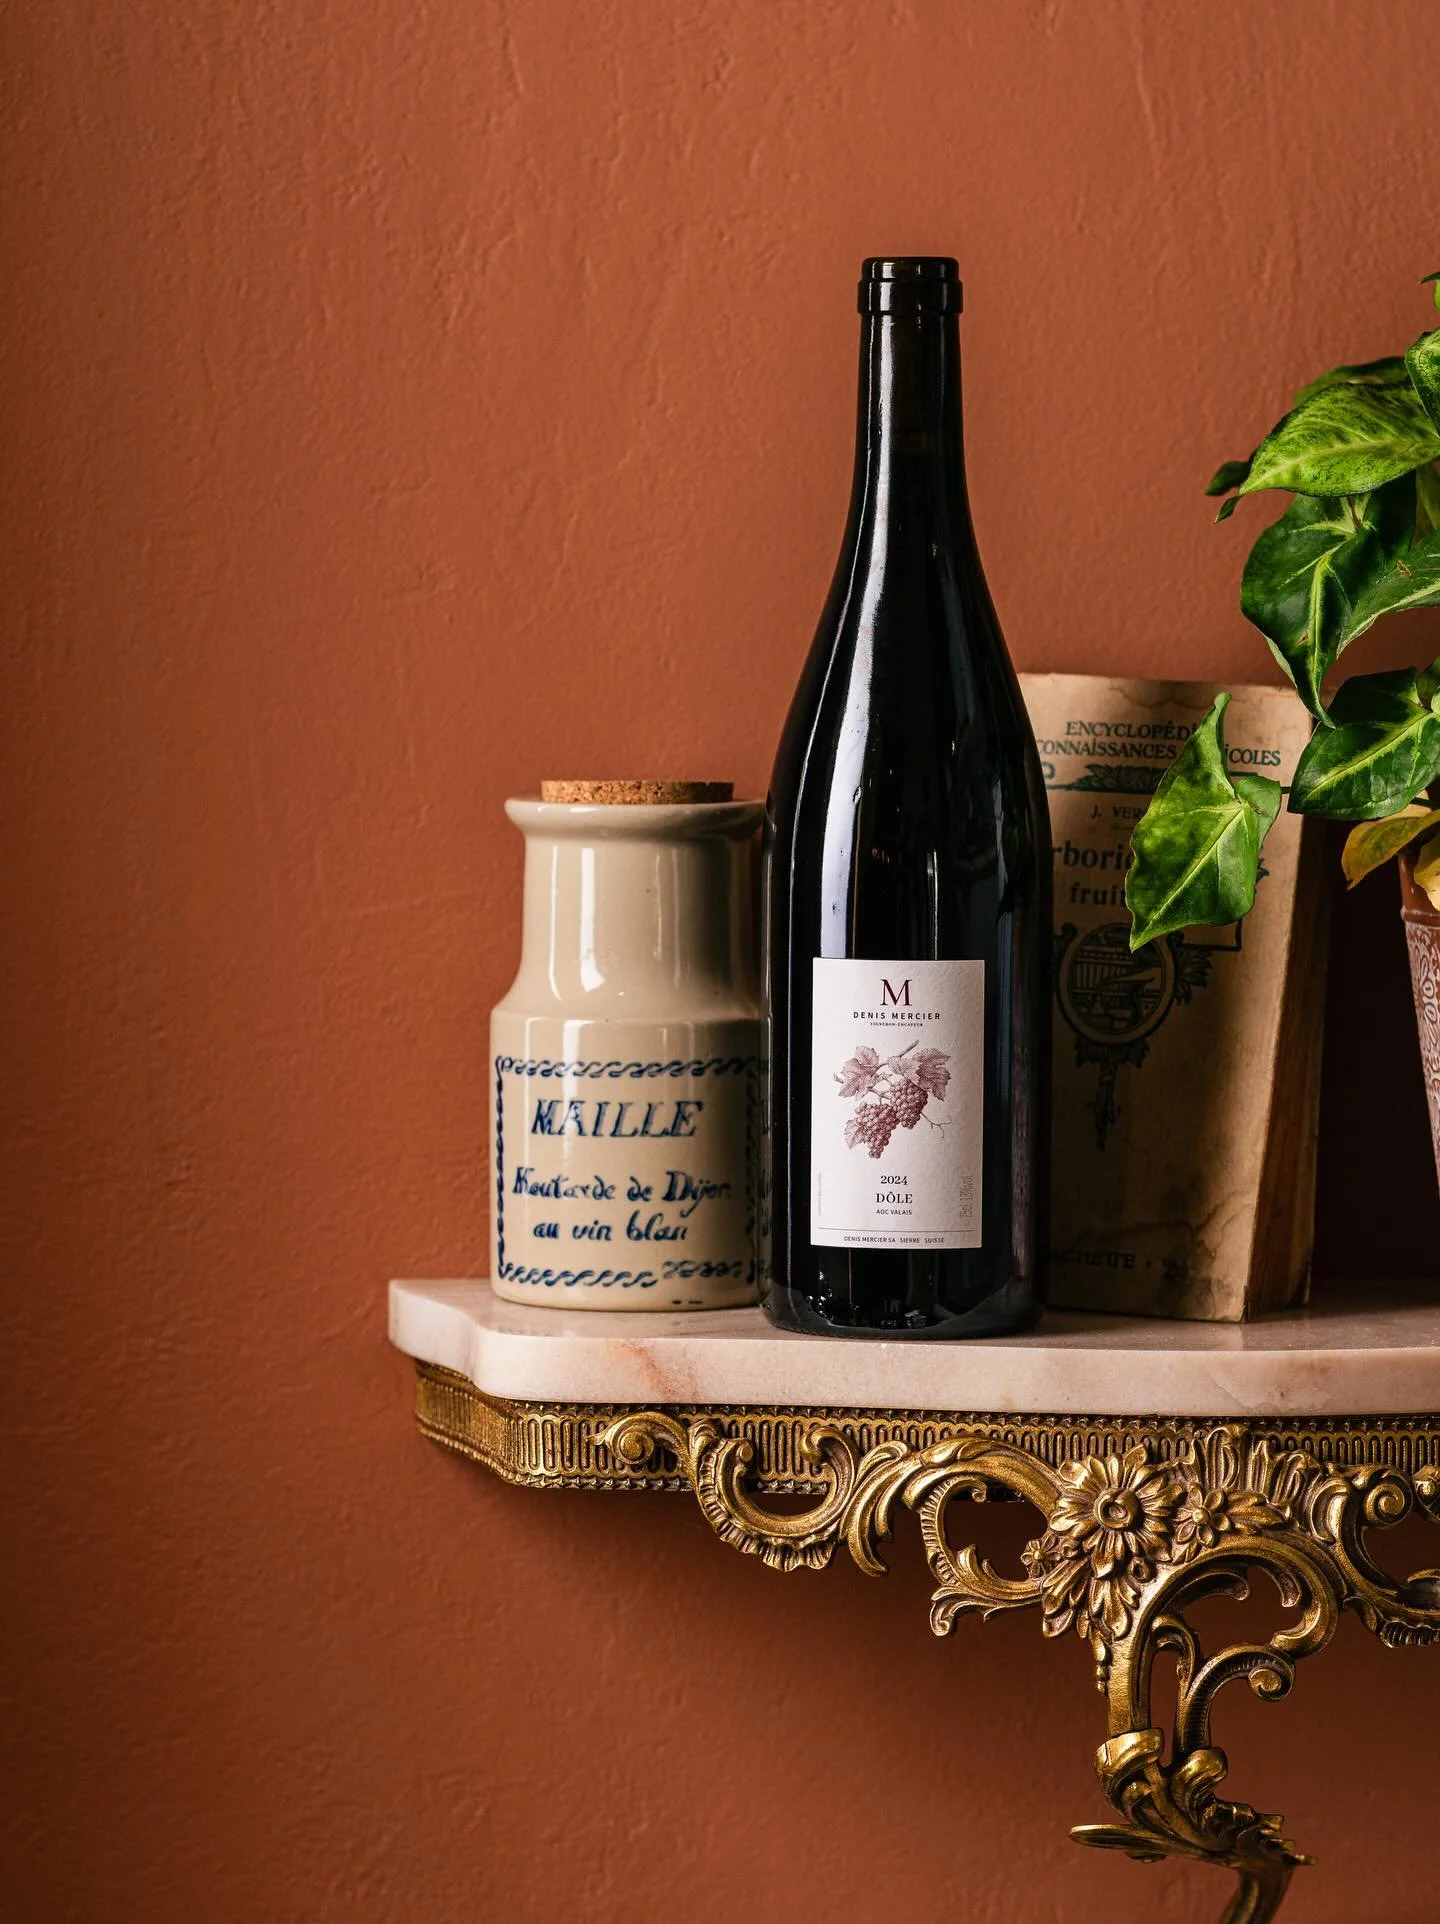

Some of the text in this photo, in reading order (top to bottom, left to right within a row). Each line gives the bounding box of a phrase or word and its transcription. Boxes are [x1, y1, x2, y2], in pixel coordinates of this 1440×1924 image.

[1224, 744, 1281, 766] ICOLES
[880, 978, 913, 1006] M
[853, 1011, 941, 1020] DENIS MERCIER
[530, 1098, 704, 1138] MAILLE
[627, 1175, 652, 1202] de
[880, 1175, 908, 1186] 2024
[876, 1191, 913, 1204] DÔLE
[533, 1222, 560, 1239] au
[572, 1220, 613, 1241] vin
